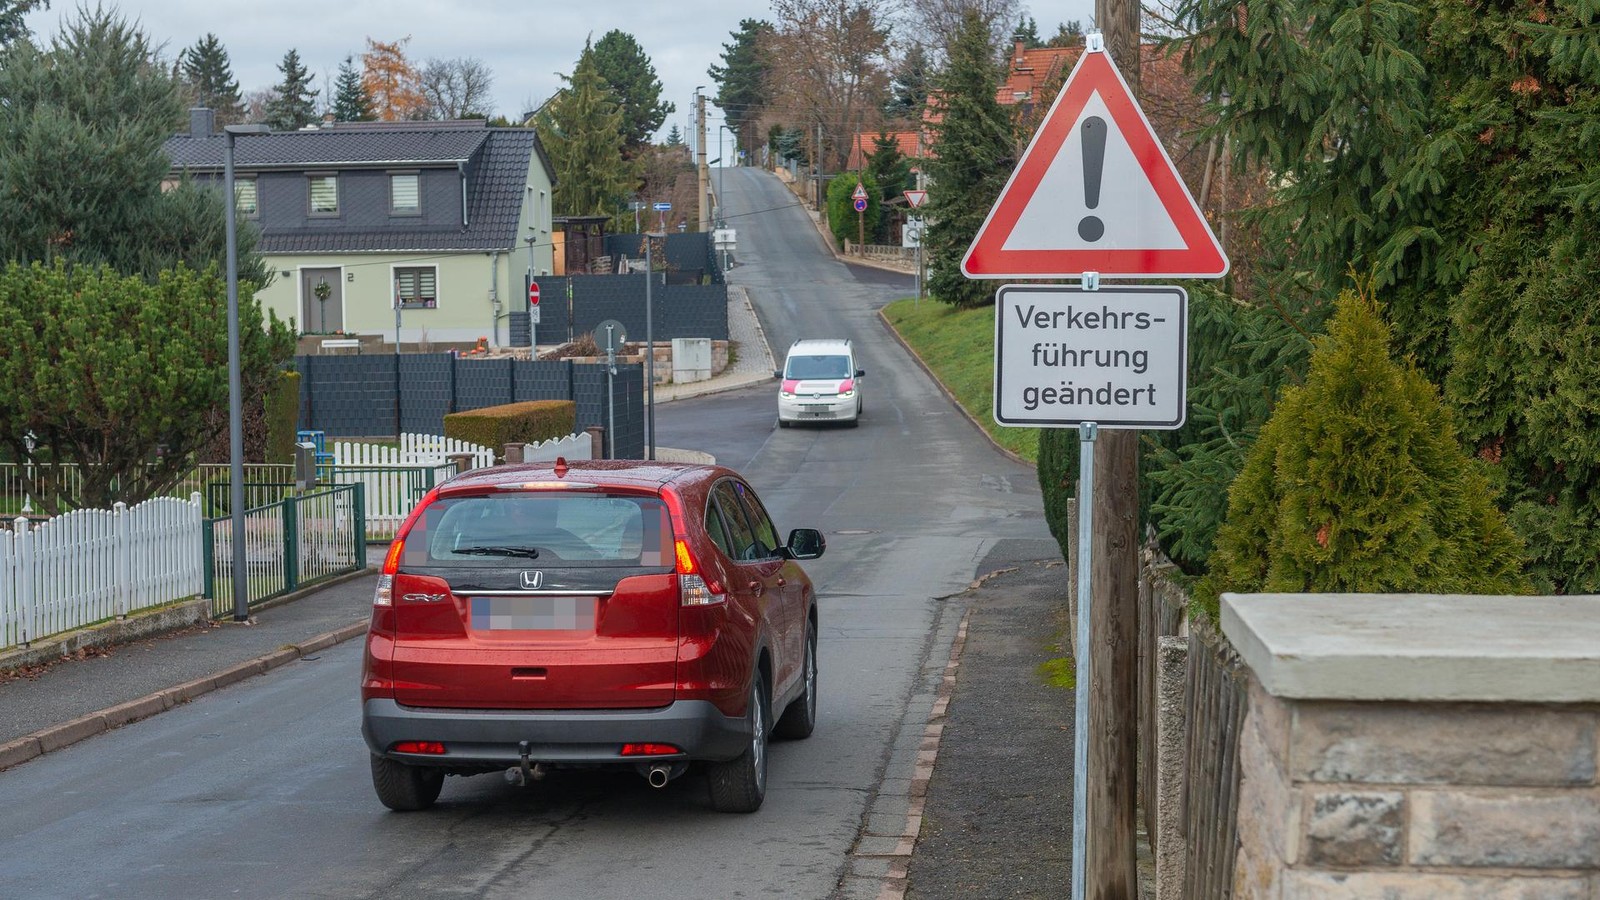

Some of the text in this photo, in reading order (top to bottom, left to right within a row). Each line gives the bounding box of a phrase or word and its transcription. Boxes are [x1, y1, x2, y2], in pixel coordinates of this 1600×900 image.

[347, 272, 354, 282] 2
[1014, 304, 1166, 330] Verkehrs-
[1031, 342, 1149, 375] führung
[1022, 381, 1157, 411] geändert
